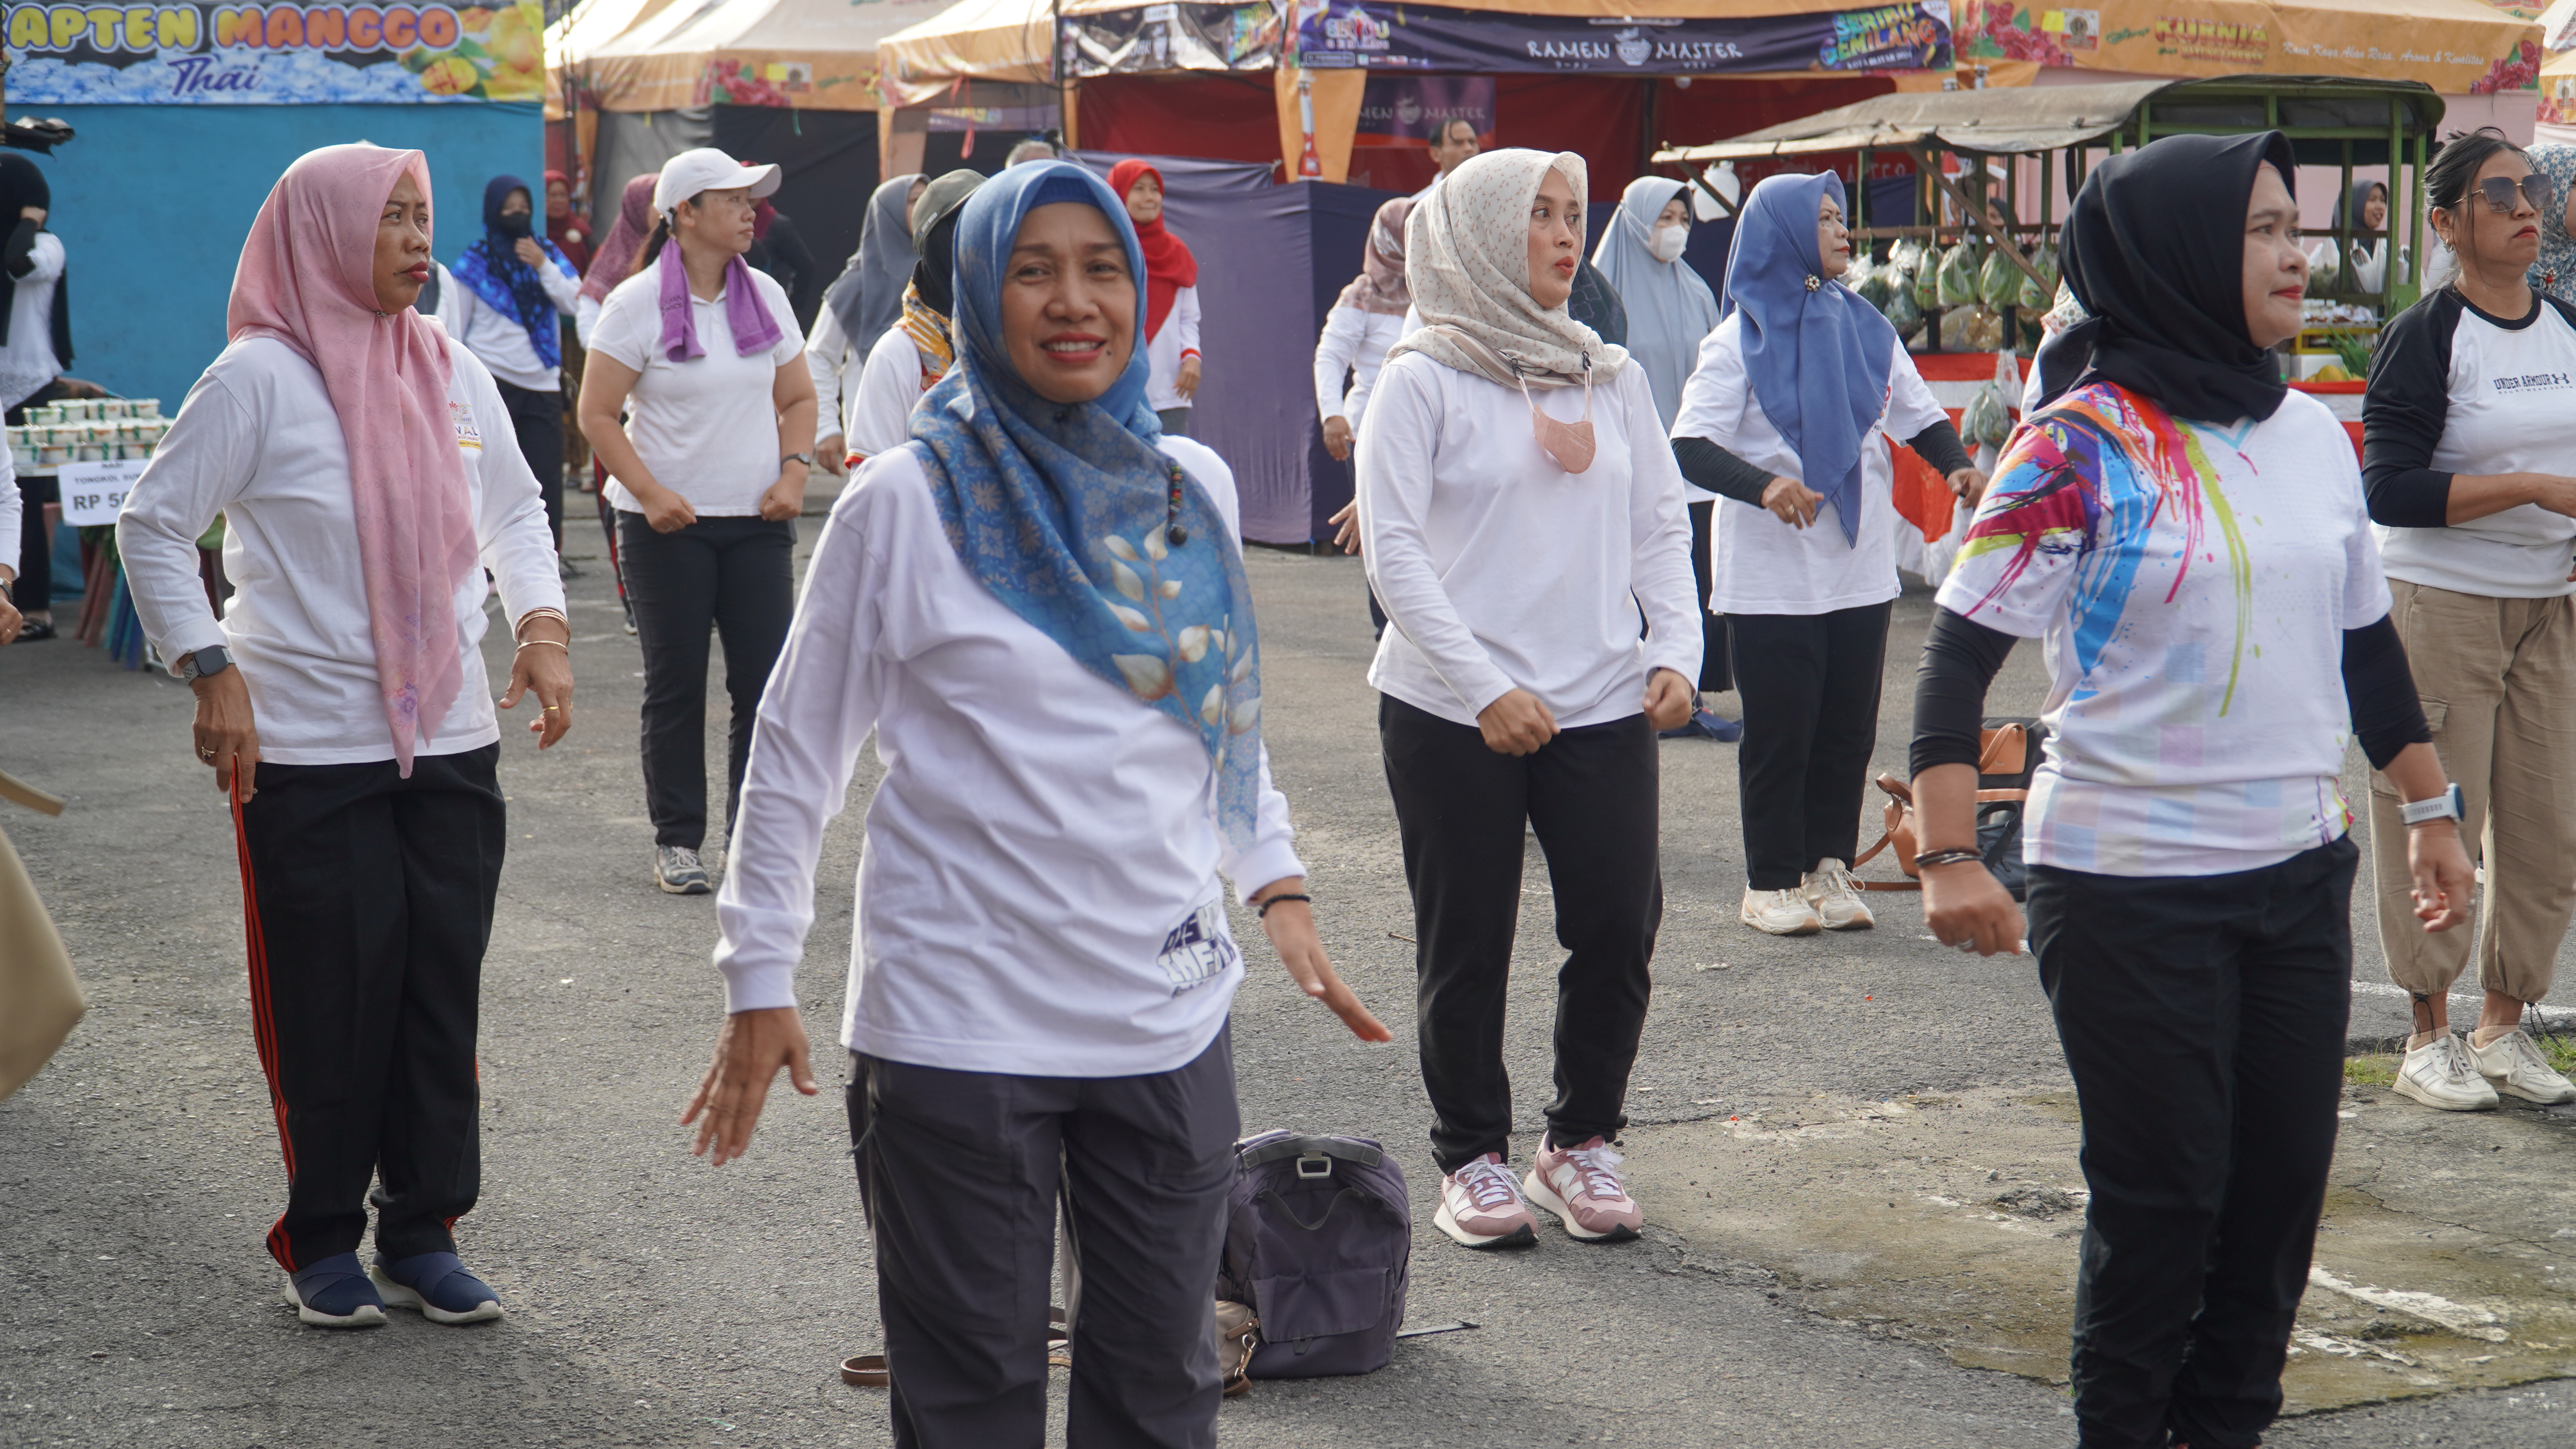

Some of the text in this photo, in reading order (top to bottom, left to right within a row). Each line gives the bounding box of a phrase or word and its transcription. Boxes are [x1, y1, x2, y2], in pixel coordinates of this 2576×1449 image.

[0, 4, 459, 50] APTEN MANGGO
[1832, 1, 1916, 36] SERIBU
[2156, 15, 2269, 48] KURNIA
[1526, 40, 1743, 59] RAMEN MASTER
[1820, 19, 1935, 66] GEMILANG
[168, 56, 260, 95] Thai
[1360, 107, 1393, 120] MEN
[2494, 374, 2553, 390] UNDER ARMOUR
[101, 459, 123, 469] NASI
[74, 474, 120, 484] TONGKOL
[73, 494, 101, 510] RP
